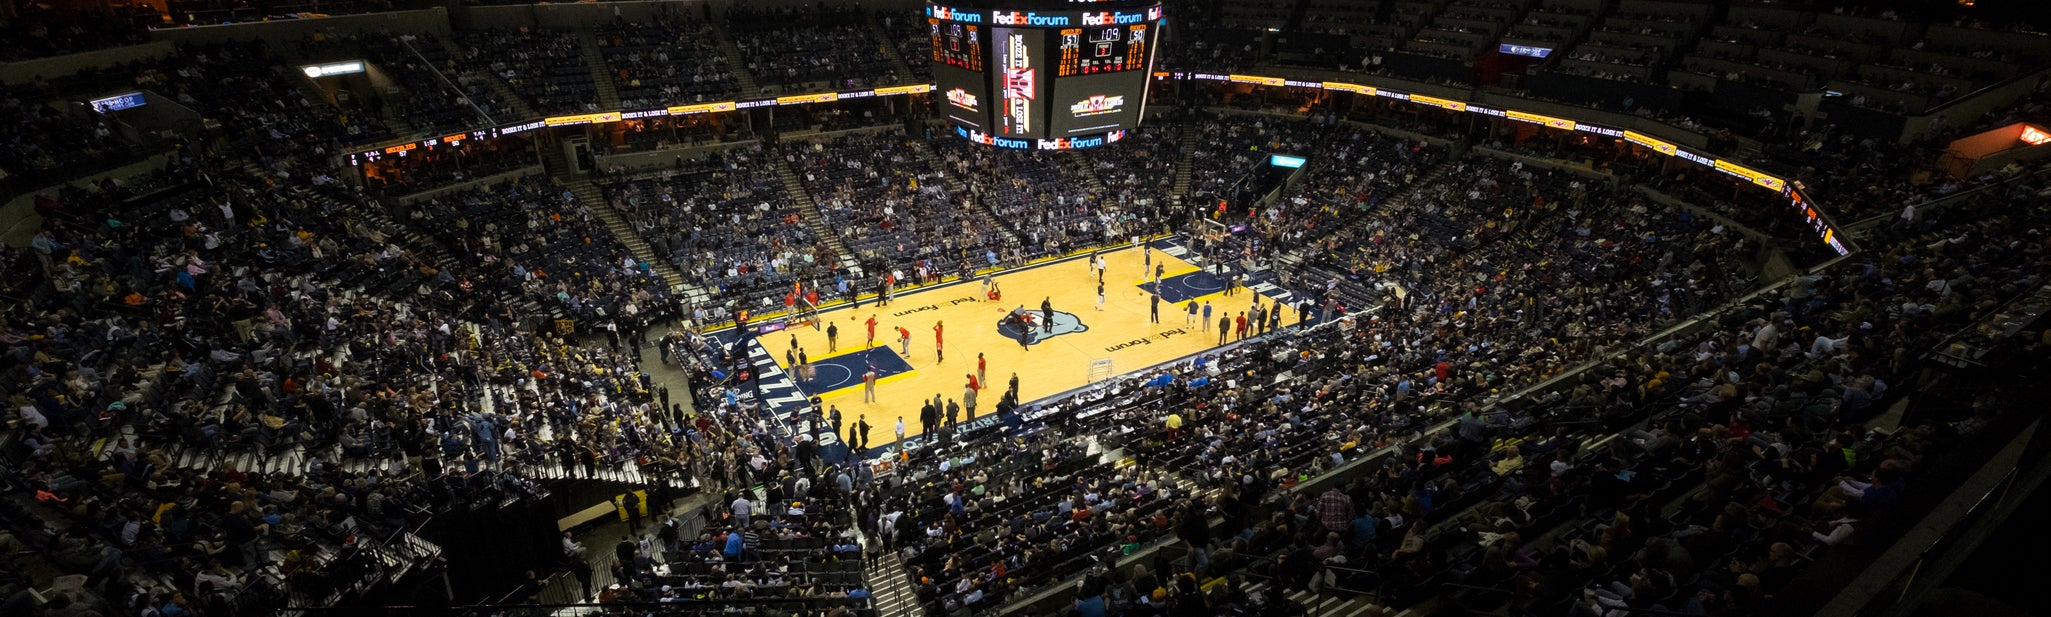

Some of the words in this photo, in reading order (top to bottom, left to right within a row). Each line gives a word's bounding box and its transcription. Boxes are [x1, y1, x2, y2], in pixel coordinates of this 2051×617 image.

[934, 5, 981, 22] FedExForum
[992, 10, 1069, 26] FedExForum
[1082, 12, 1142, 26] FedExForum
[1067, 35, 1077, 45] 57
[1133, 31, 1143, 40] 50
[1014, 34, 1023, 58] BOOZE
[1015, 59, 1023, 68] IT
[1016, 106, 1024, 123] LOSE
[970, 129, 1028, 149] FedExForum
[1037, 136, 1102, 151] FedExForum
